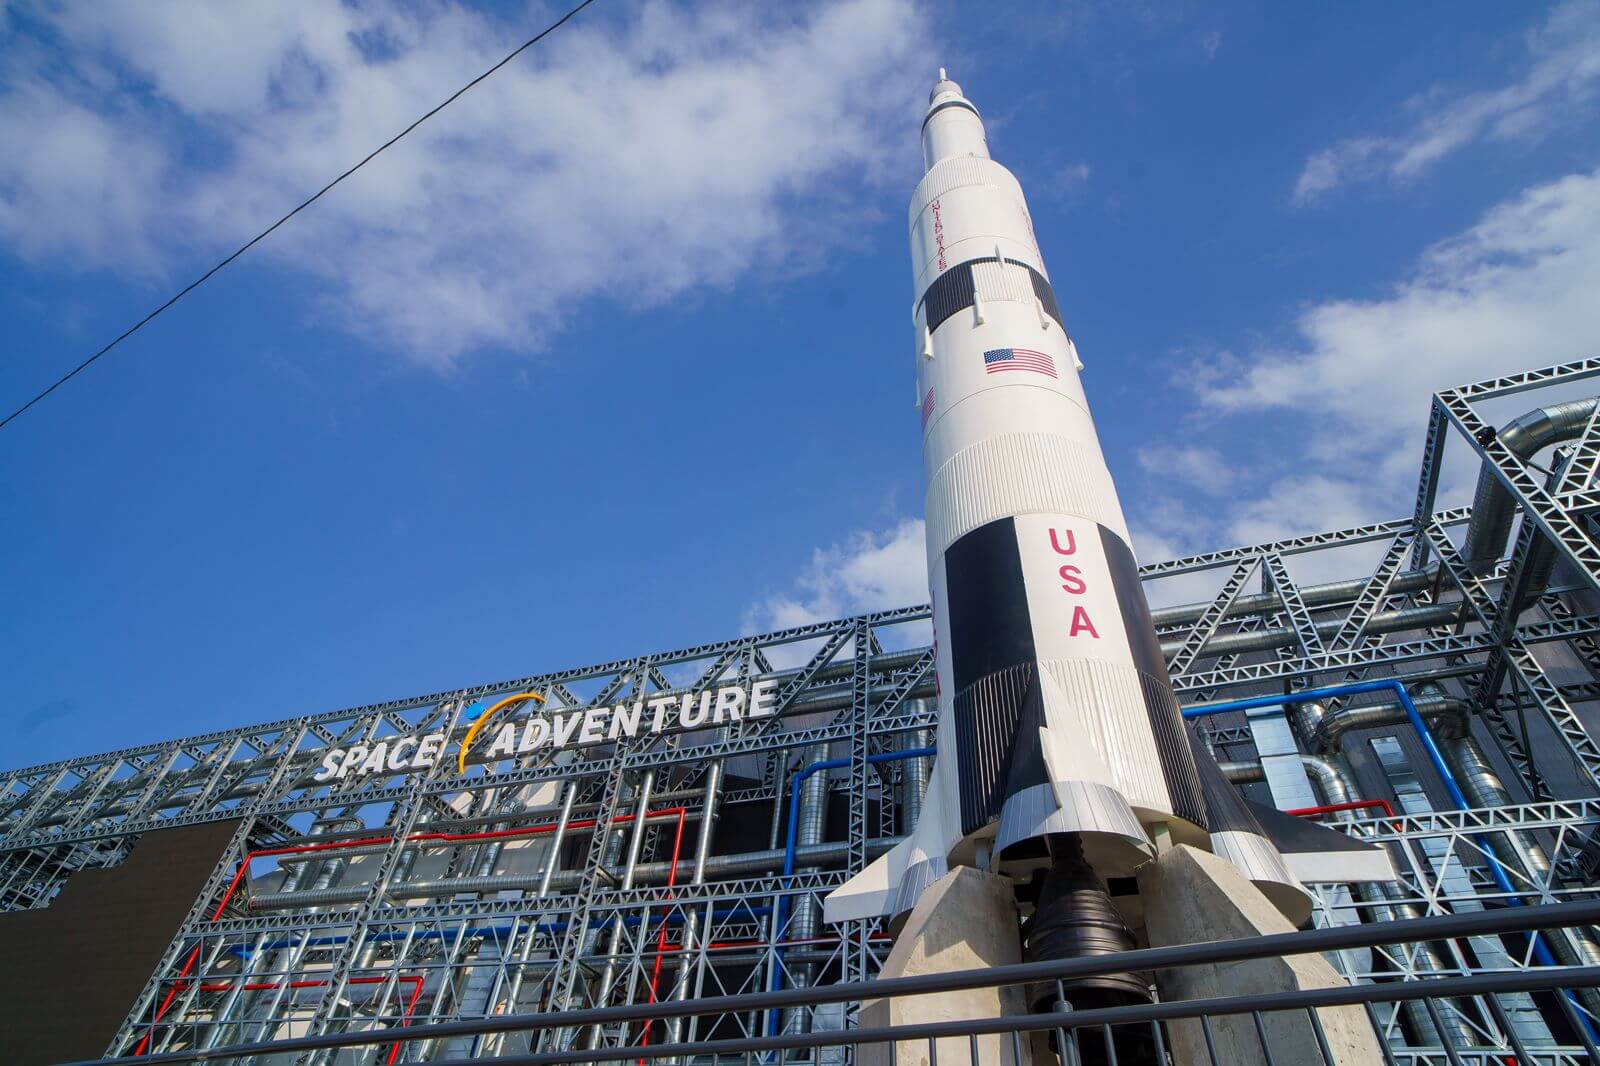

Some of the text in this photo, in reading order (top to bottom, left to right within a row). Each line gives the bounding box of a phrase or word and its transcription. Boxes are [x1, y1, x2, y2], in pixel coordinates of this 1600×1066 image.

[1048, 528, 1100, 639] USA
[313, 679, 779, 783] SPACE ADVENTURE
